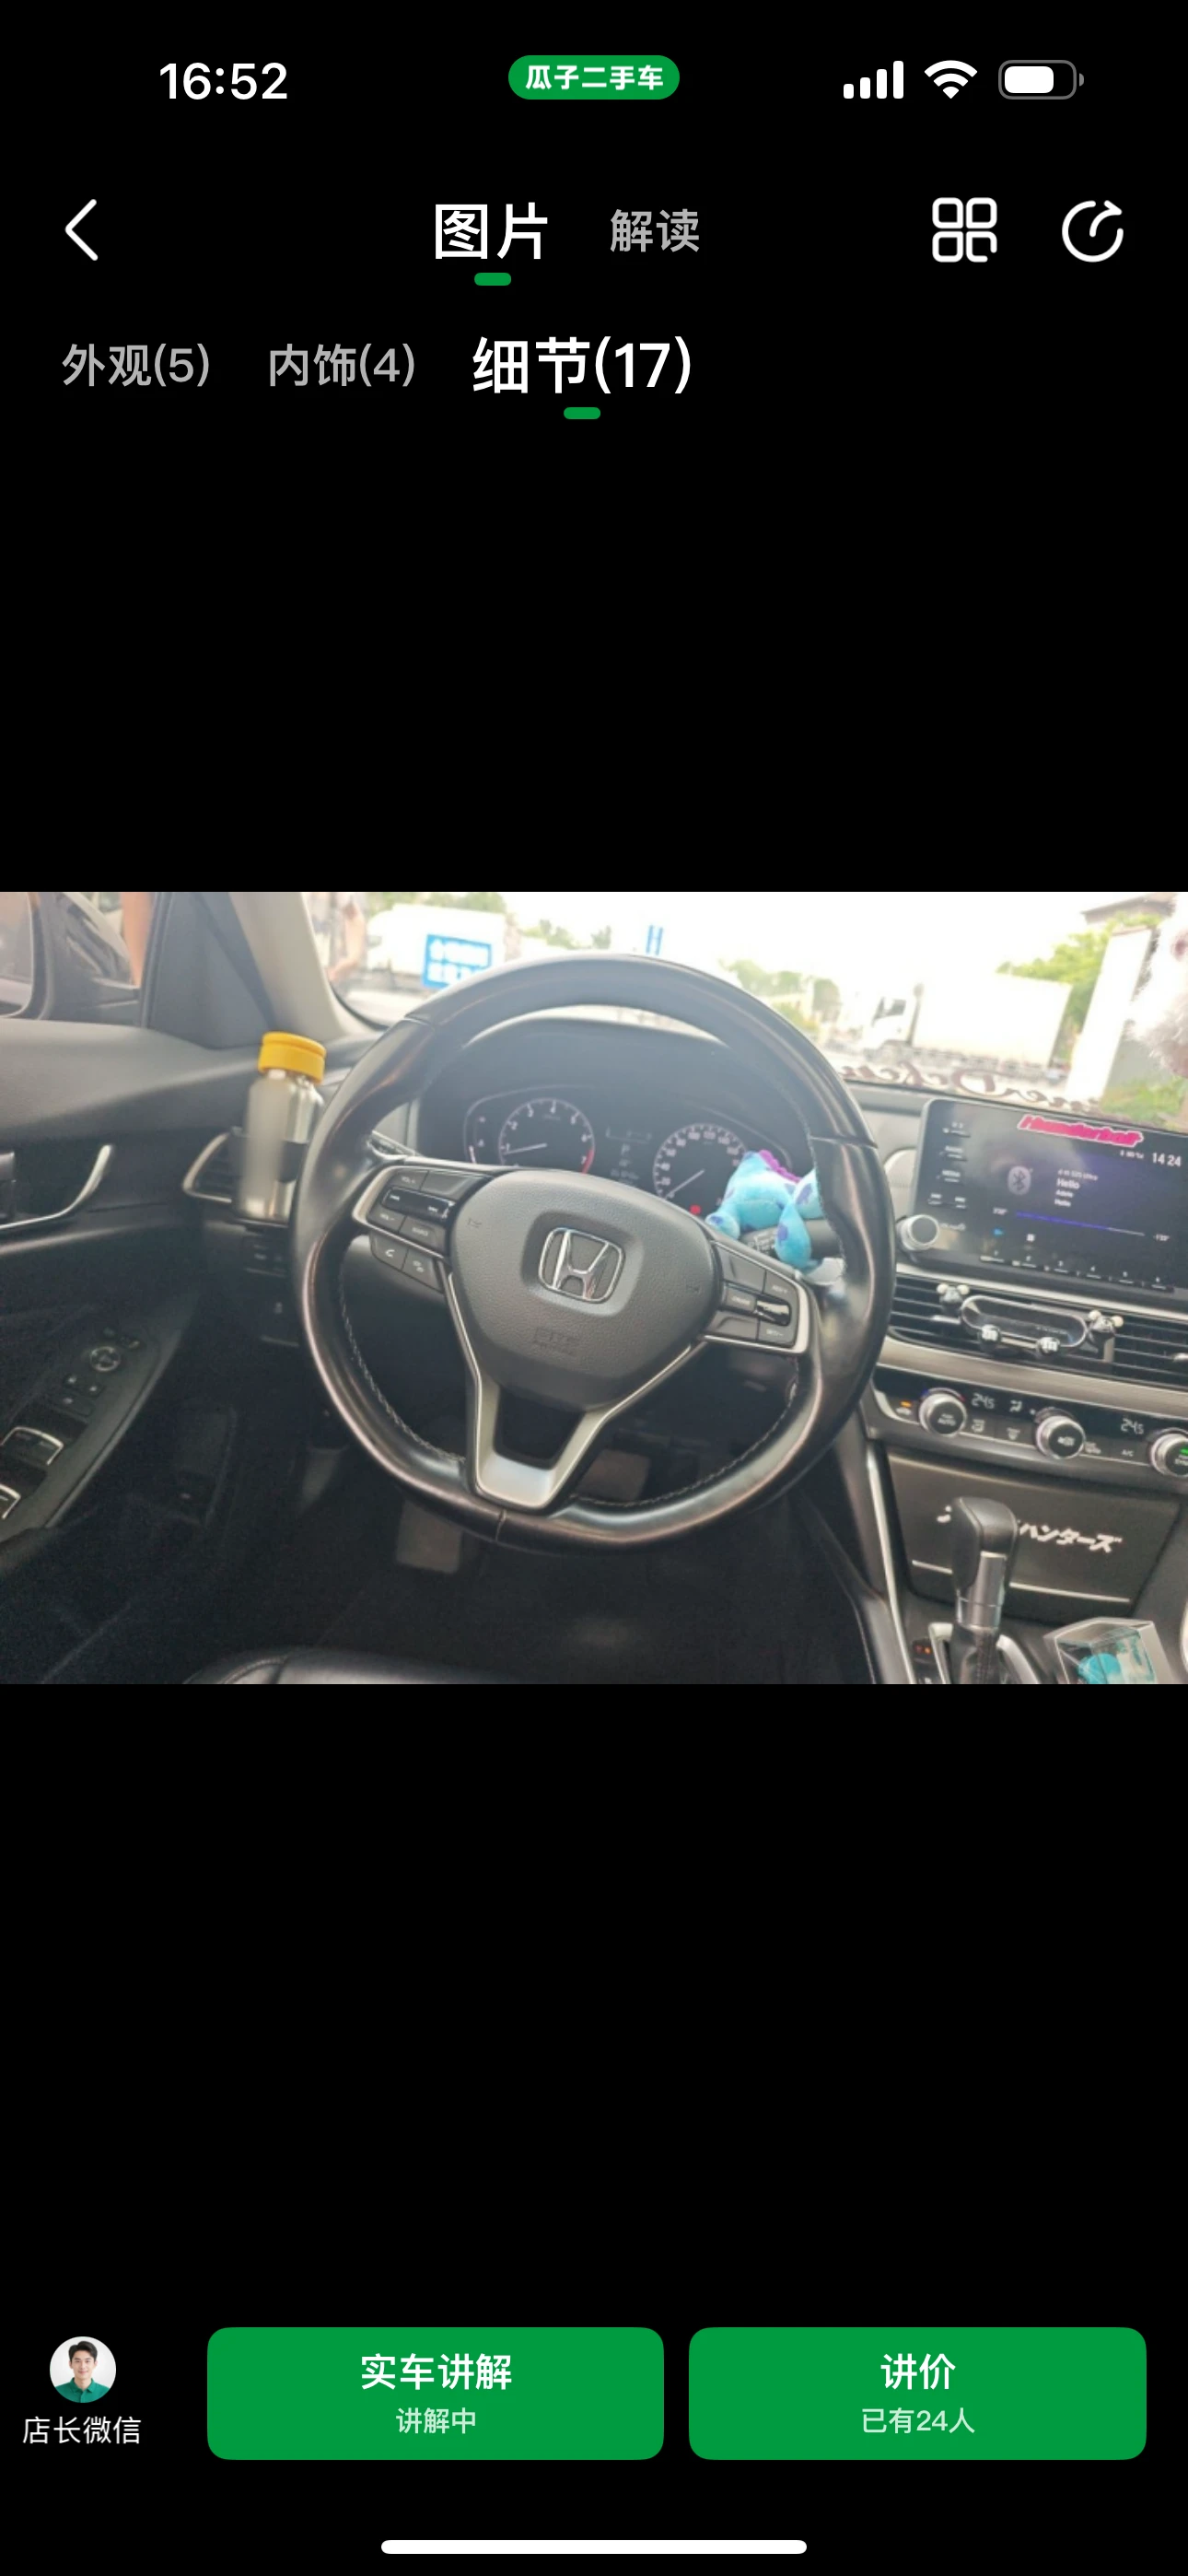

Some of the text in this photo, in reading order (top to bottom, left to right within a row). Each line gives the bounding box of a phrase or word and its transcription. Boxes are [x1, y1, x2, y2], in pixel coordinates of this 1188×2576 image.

[159, 62, 288, 100] 16:52
[525, 64, 664, 91] 瓜子二手车
[435, 201, 548, 260] 图片
[610, 208, 700, 252] 解读
[62, 343, 209, 387] 外观(5)
[270, 343, 414, 387] 内饰(4)
[472, 335, 691, 394] 细节(17)
[361, 2352, 512, 2391] 实车讲解
[880, 2353, 956, 2390] 讲价
[22, 2416, 142, 2444] 店长微信
[395, 2406, 476, 2434] 讲解中
[862, 2406, 975, 2434] 已有24人
